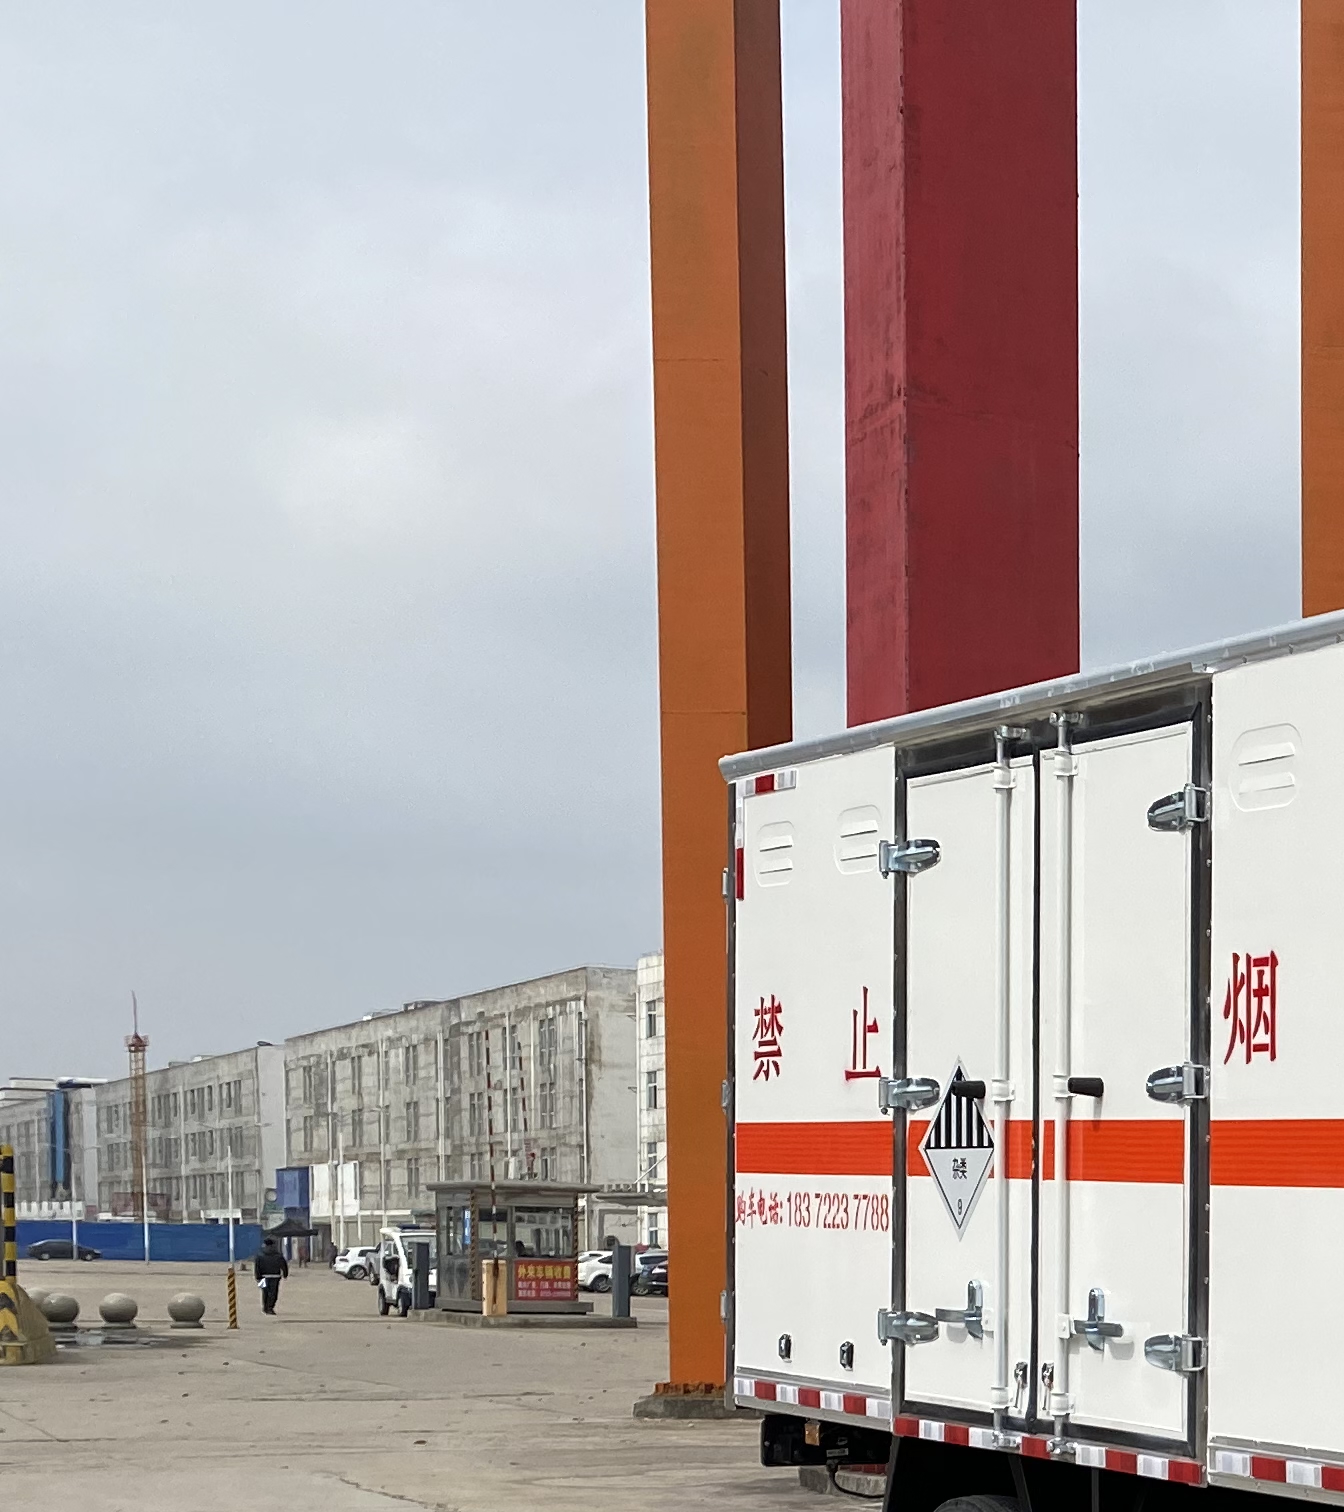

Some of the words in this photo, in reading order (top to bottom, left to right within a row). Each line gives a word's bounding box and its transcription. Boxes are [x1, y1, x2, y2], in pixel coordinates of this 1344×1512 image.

[786, 1191, 811, 1228] 183
[814, 1192, 849, 1230] 7223
[852, 1193, 890, 1232] 7788
